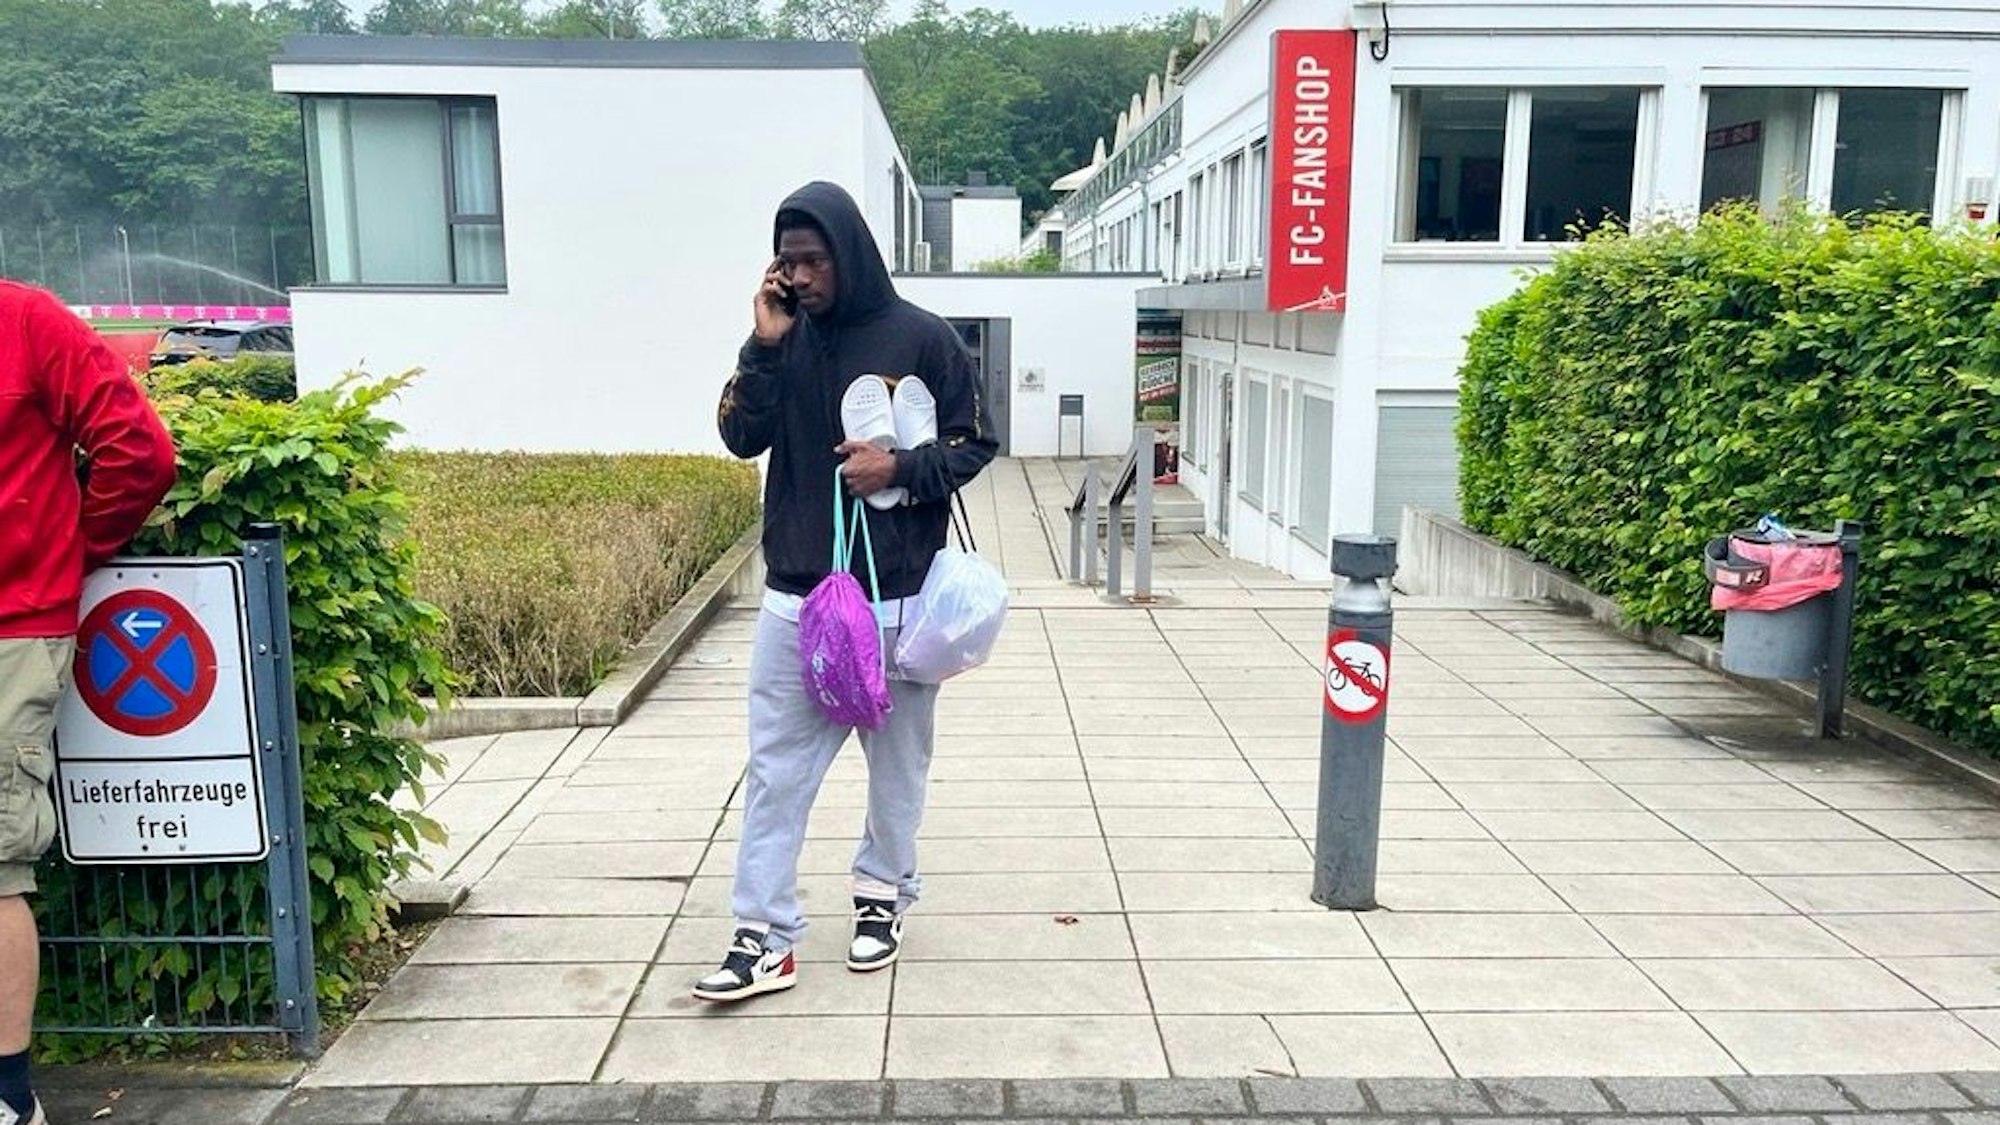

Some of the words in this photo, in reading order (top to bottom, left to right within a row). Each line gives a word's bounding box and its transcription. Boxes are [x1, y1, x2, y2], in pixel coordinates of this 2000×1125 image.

[1290, 56, 1331, 265] FC-FANSHOP
[70, 779, 248, 806] Lieferfahrzeuge
[137, 815, 188, 839] frei
